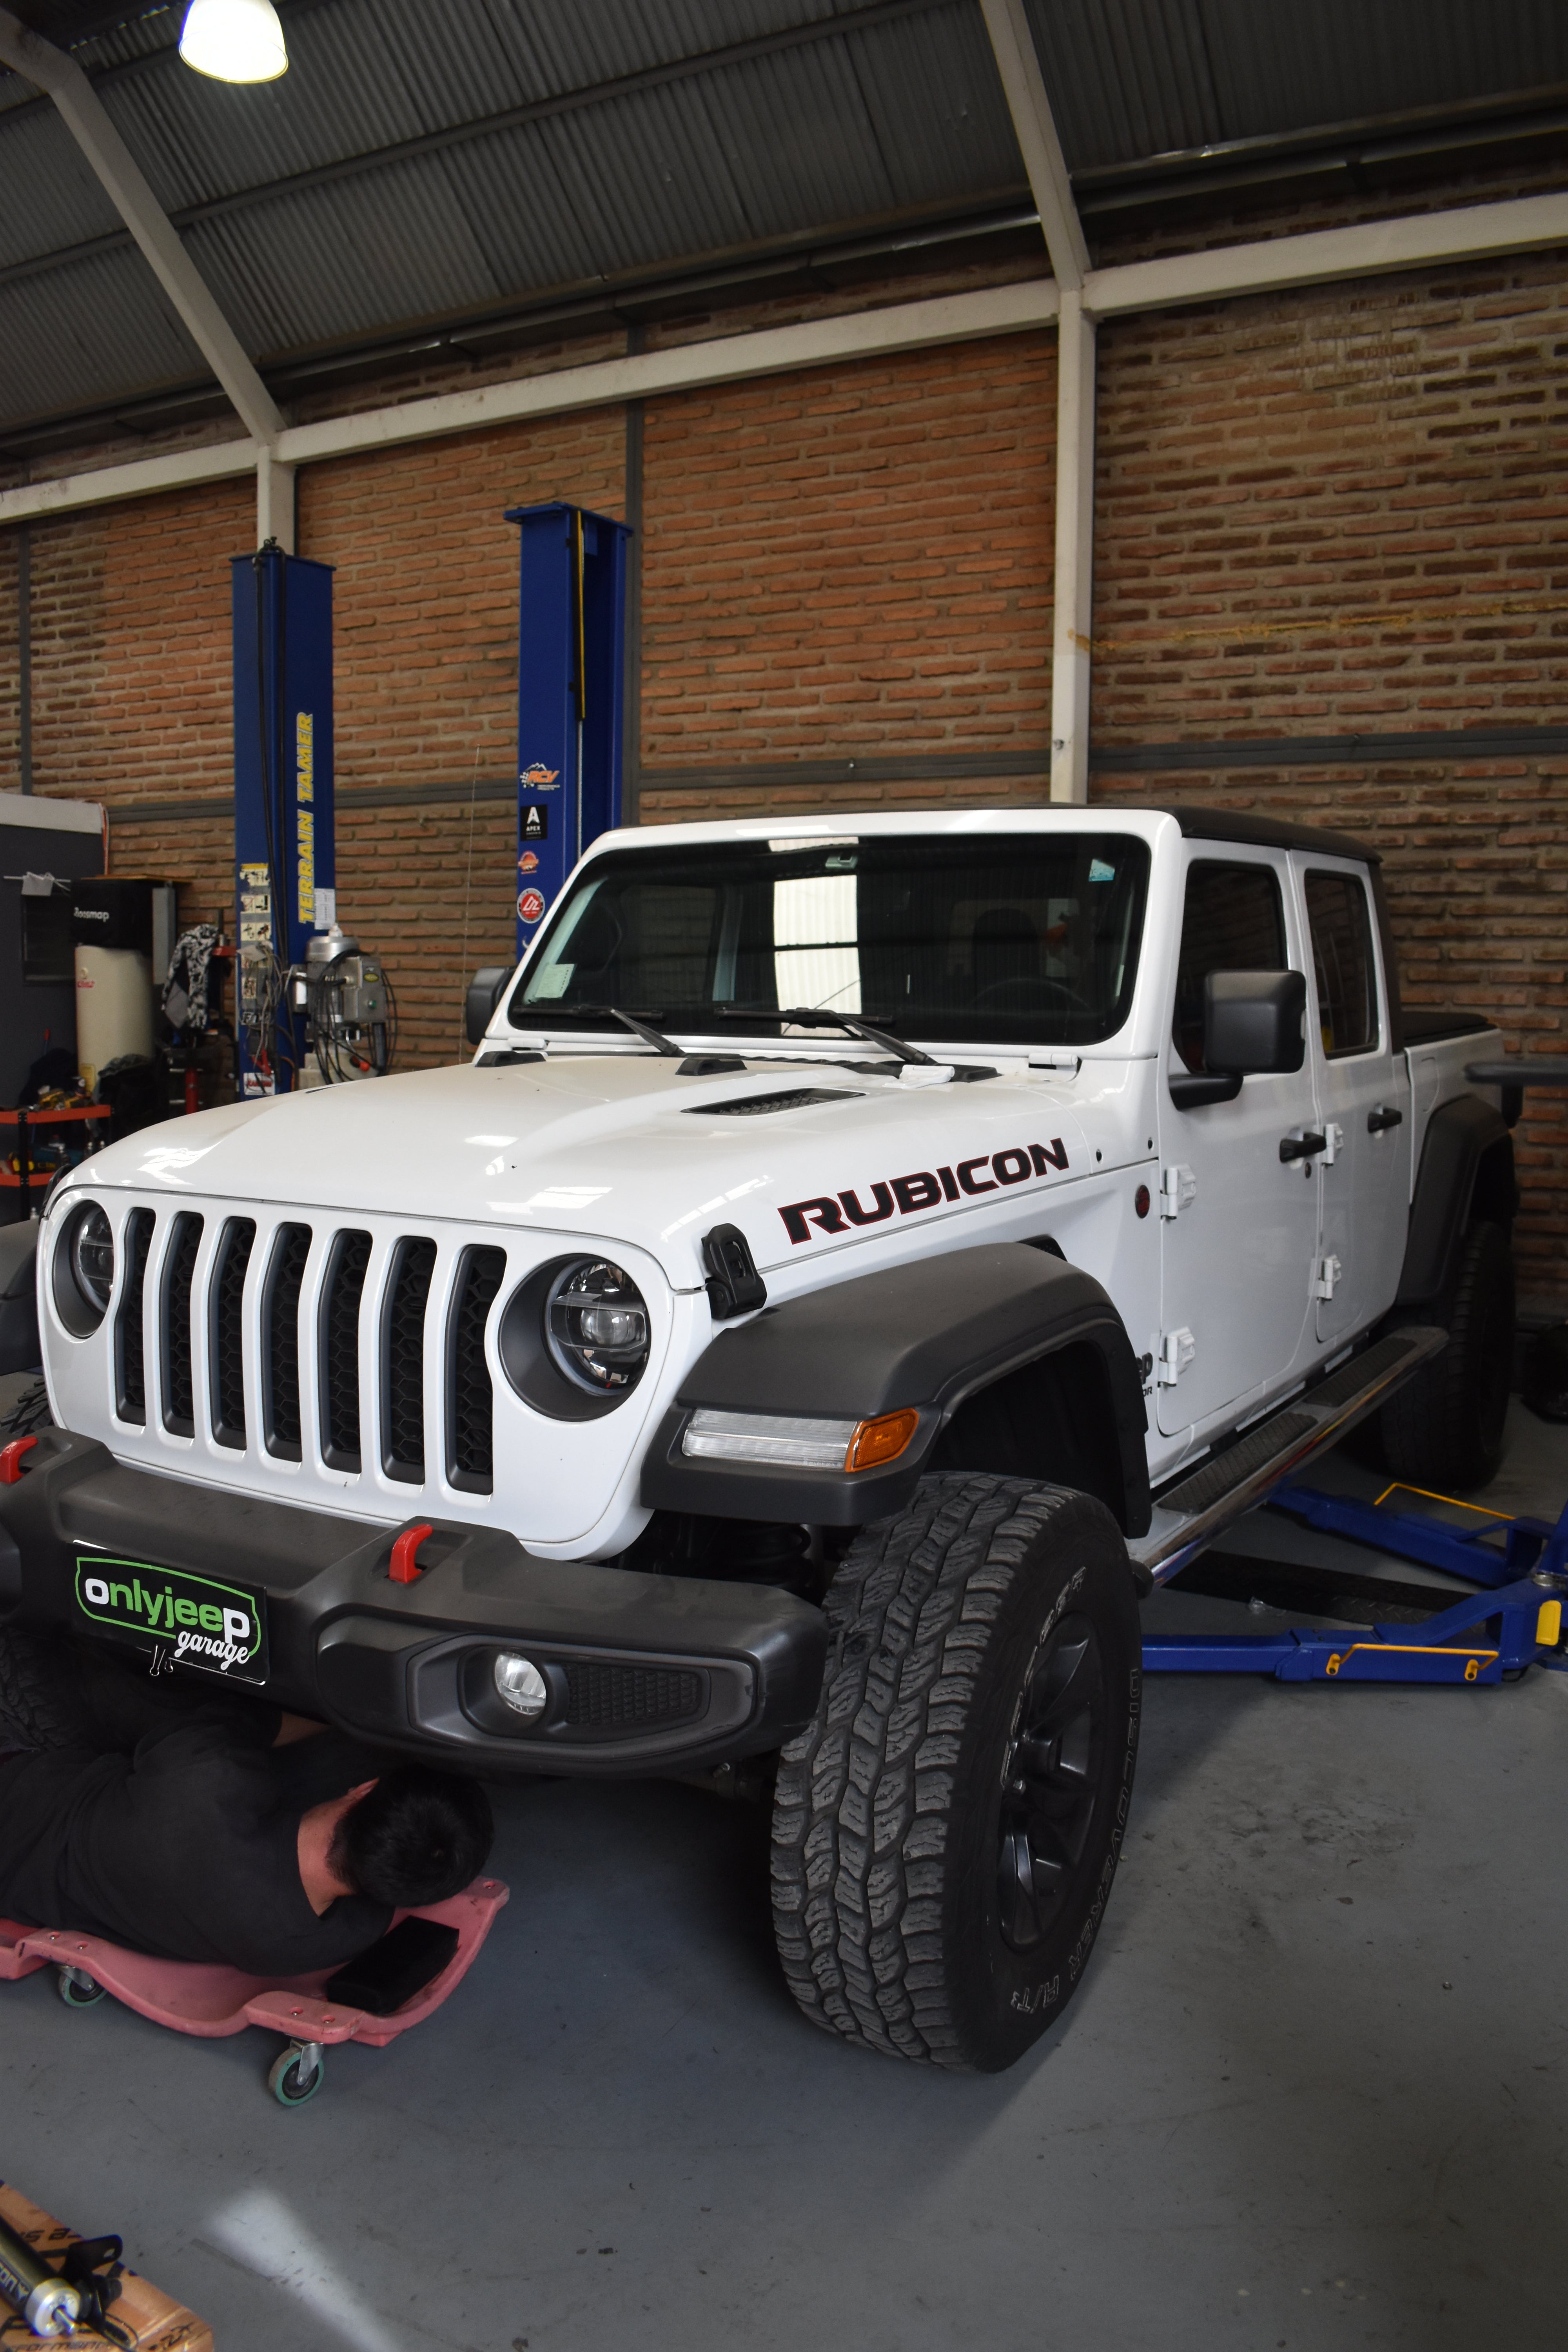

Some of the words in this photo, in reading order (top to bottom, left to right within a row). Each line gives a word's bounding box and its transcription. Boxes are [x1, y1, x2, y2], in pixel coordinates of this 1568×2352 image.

[297, 712, 314, 802] TAMER
[527, 770, 560, 783] RCV
[298, 809, 314, 924] TERRAIN
[777, 1138, 1069, 1245] RUBICON
[85, 1578, 250, 1644] onlyjeep
[174, 1630, 250, 1670] garage
[1068, 1668, 1140, 1981] DISCOVERER
